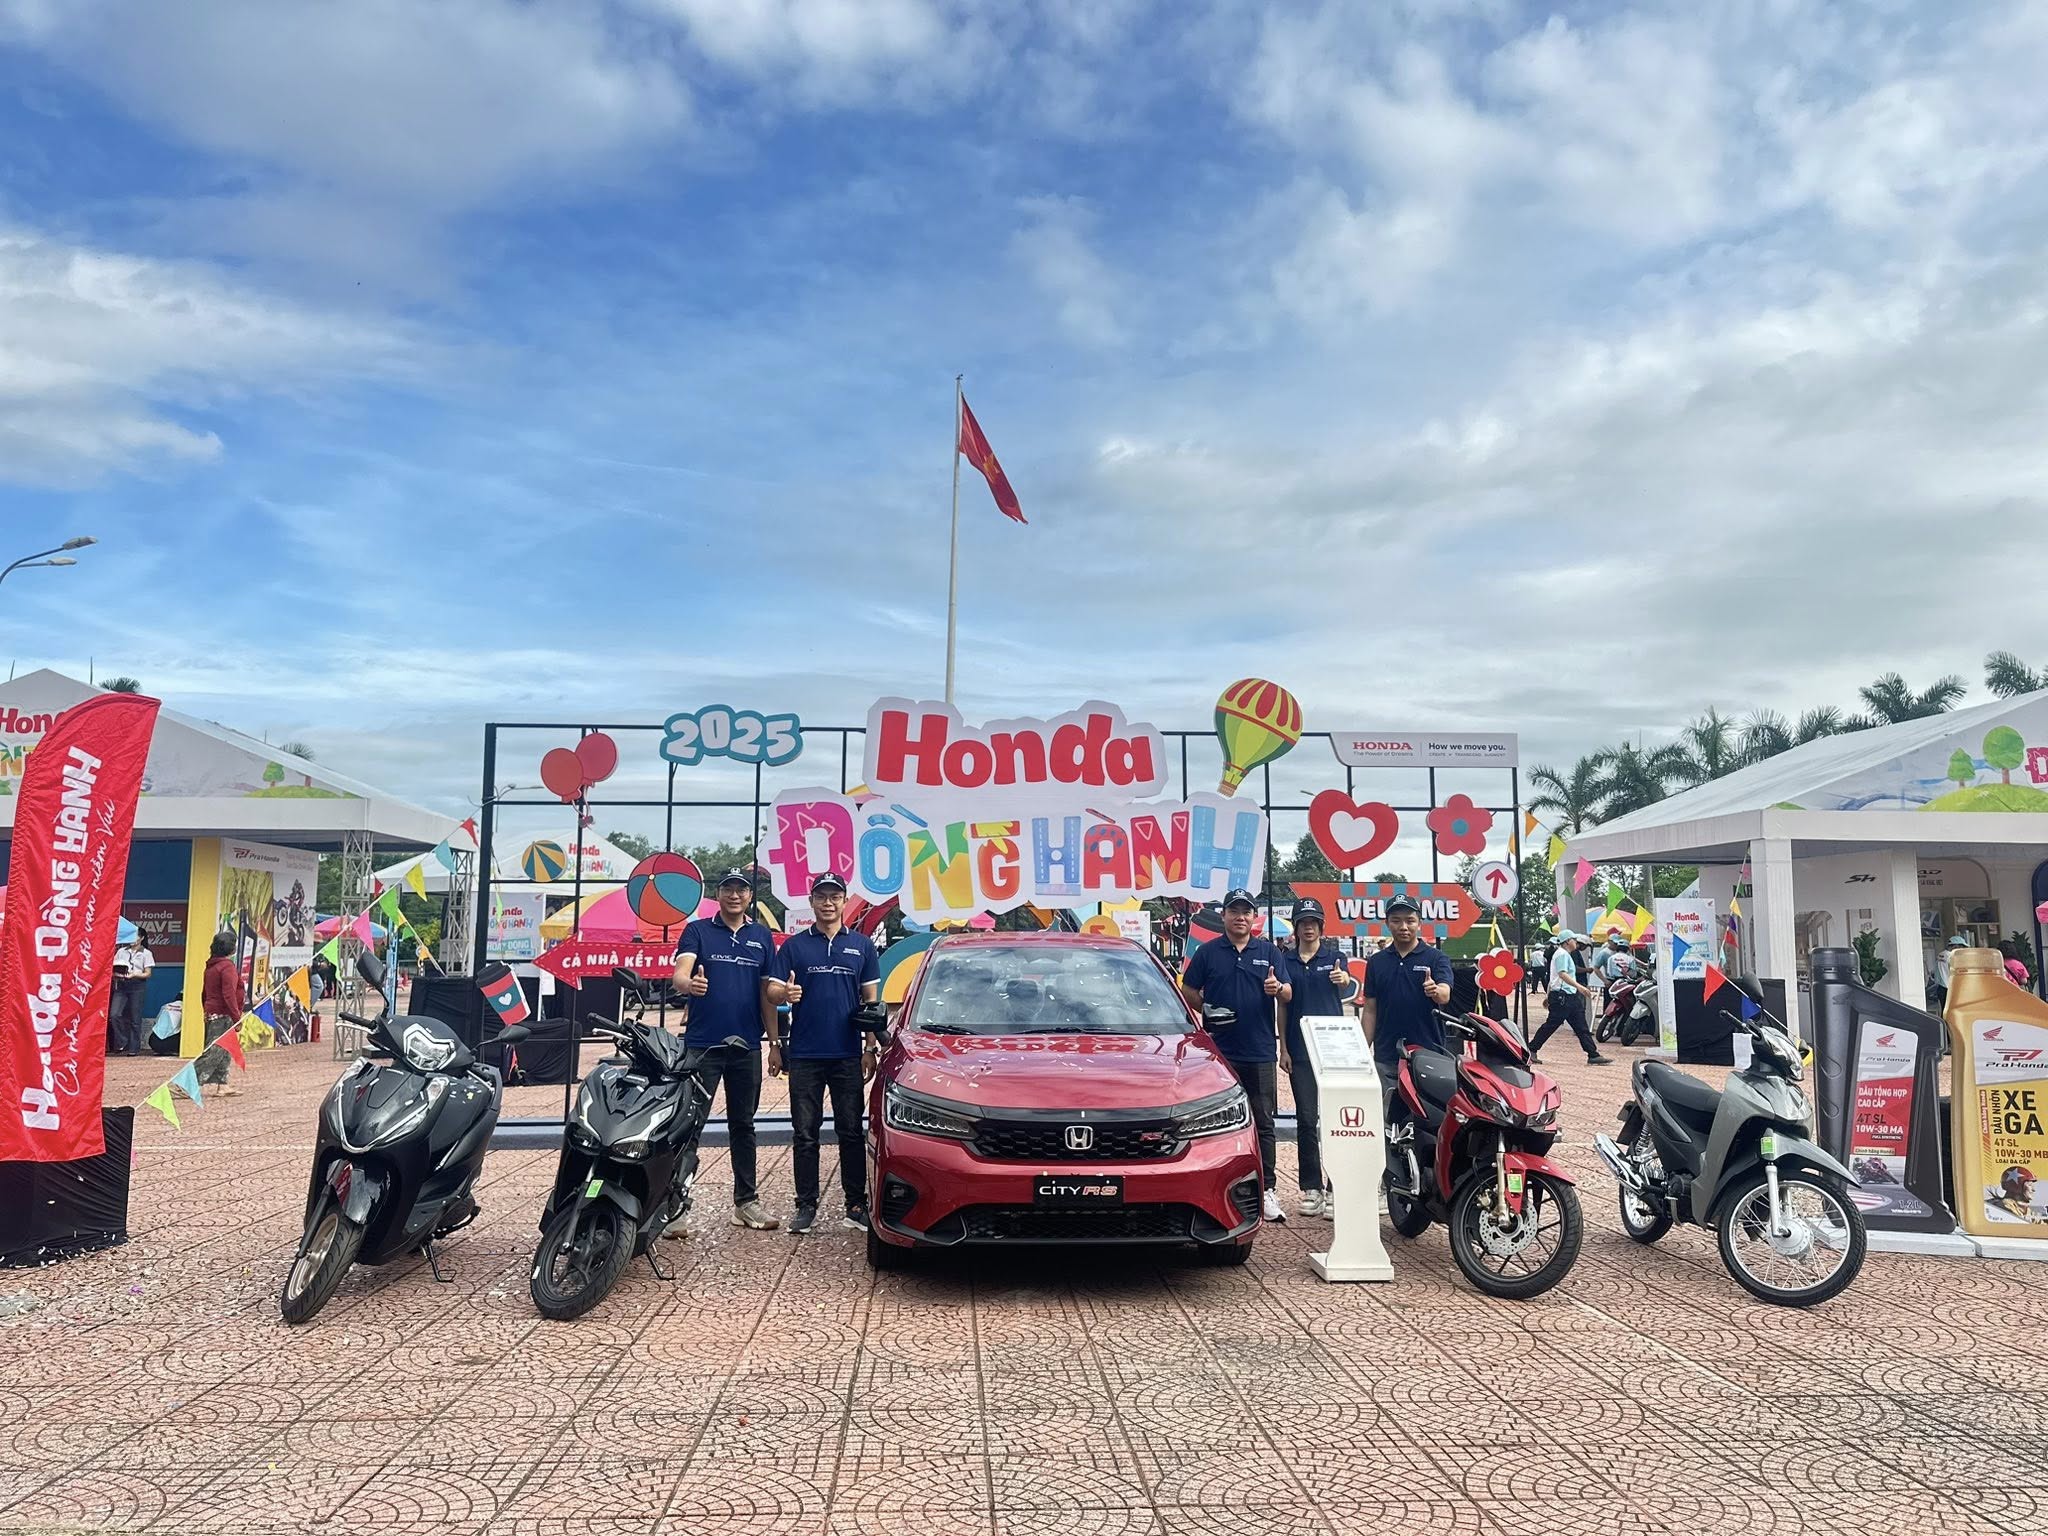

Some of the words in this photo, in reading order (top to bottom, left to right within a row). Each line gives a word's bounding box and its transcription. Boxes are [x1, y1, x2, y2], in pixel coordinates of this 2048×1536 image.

[0, 707, 60, 734] Hon
[666, 709, 794, 759] 2025
[875, 710, 1156, 788] Honda
[1352, 741, 1413, 750] HONDA
[1428, 742, 1448, 750] How
[1488, 744, 1506, 752] you.
[53, 745, 102, 854] HÀNH
[568, 843, 600, 856] Hnda
[768, 801, 1021, 912] ĐỒNG
[1031, 803, 1261, 897] HÀNH
[35, 858, 81, 962] ĐỒNG
[140, 910, 173, 919] Honda
[492, 907, 523, 916] Hnda
[1336, 899, 1460, 919] WELME
[1674, 912, 1699, 921] Honda
[562, 952, 581, 968] CẢ
[586, 950, 619, 966] NHÀ
[624, 949, 653, 967] KẾT
[658, 948, 678, 967] NỐ
[1858, 1099, 1871, 1107] CAO
[1989, 1090, 2001, 1115] NHỜN
[2003, 1090, 2036, 1111] XE
[1857, 1113, 1871, 1123] 4T
[1873, 1114, 1886, 1124] SL
[2004, 1111, 2045, 1135] GA
[1856, 1125, 1889, 1133] 10W-30
[1890, 1125, 1904, 1134] MA
[1990, 1116, 2003, 1135] DẦU
[1330, 1130, 1375, 1138] HONDA
[1994, 1138, 2005, 1147] 4T
[2007, 1139, 2019, 1147] SL
[1995, 1149, 2032, 1158] 10W-30
[2034, 1150, 2048, 1158] MB
[1039, 1186, 1081, 1195] CITY
[1082, 1186, 1118, 1196] RS
